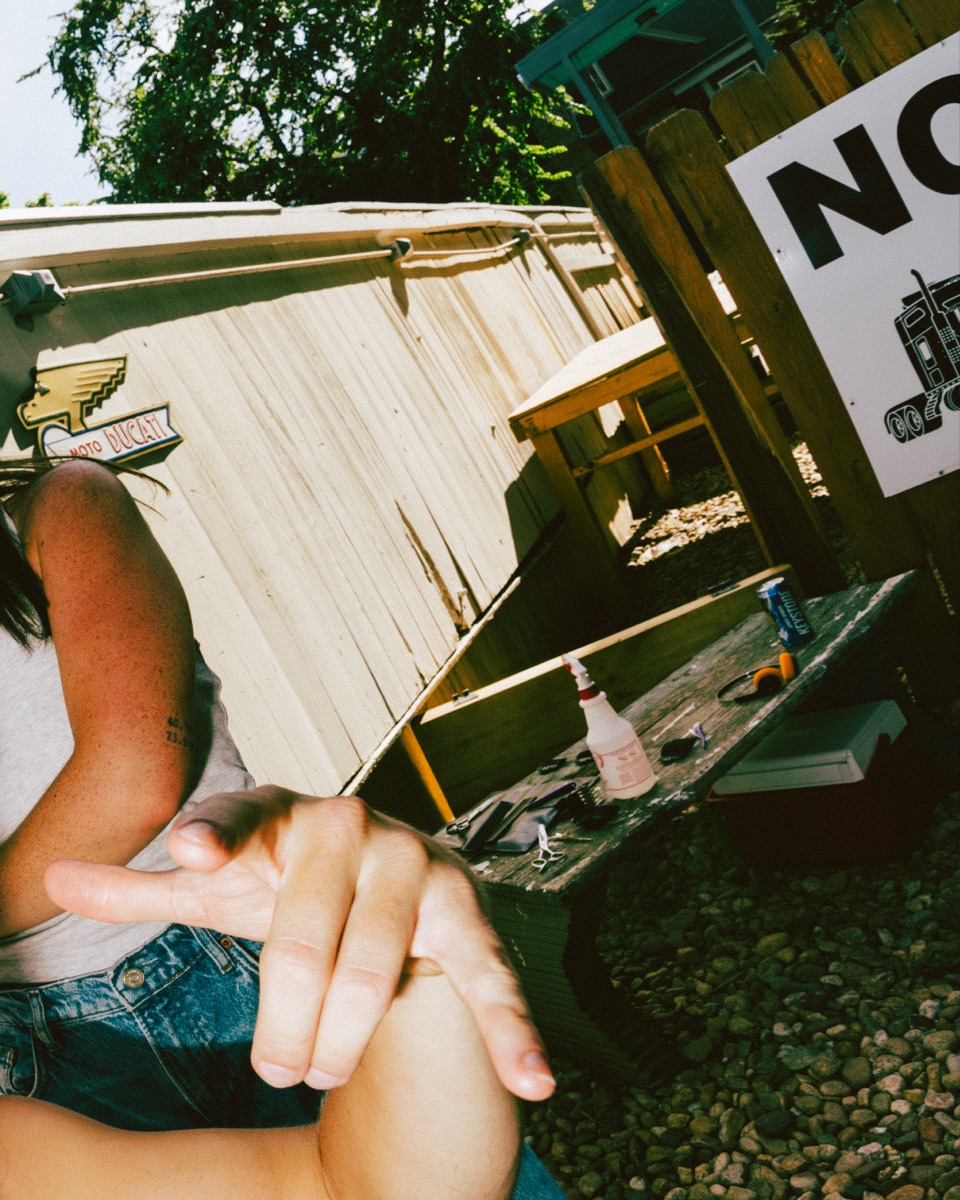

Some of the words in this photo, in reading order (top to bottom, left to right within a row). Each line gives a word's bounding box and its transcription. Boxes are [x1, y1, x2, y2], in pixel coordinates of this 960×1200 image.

[70, 440, 102, 457] MOTO
[103, 413, 167, 454] DUCATI
[780, 590, 813, 637] KEYSTONE
